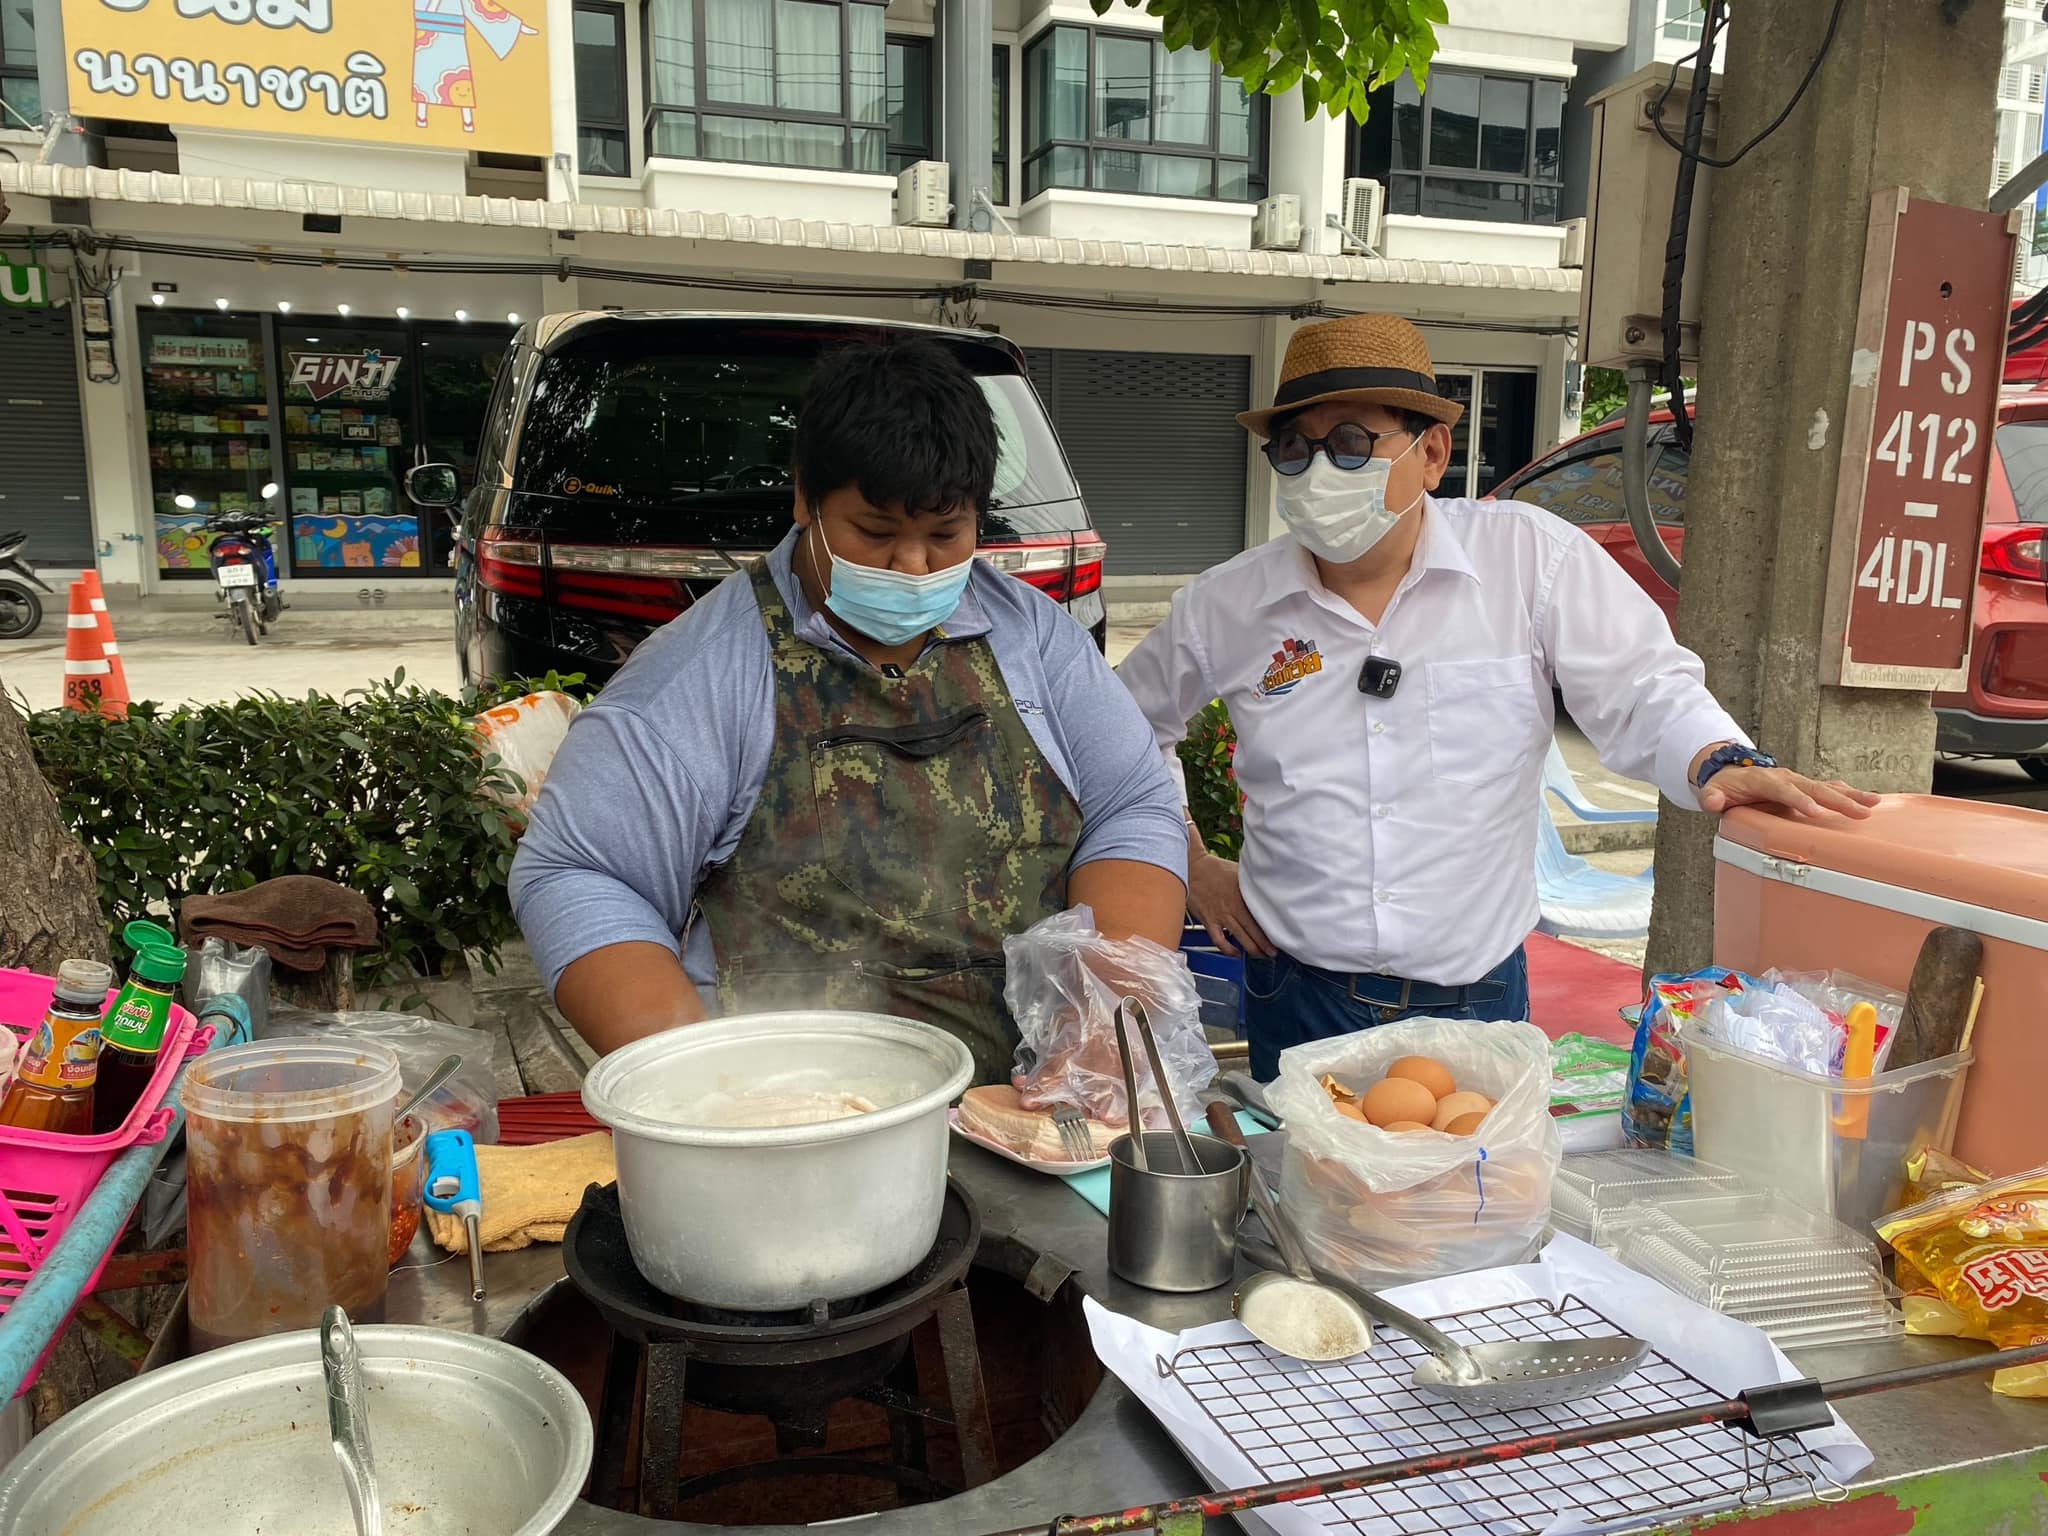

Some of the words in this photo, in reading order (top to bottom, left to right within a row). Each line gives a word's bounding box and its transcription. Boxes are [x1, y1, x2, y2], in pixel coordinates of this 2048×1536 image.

[75, 48, 389, 120] นานาชาติ
[1898, 319, 1976, 395] PS
[1875, 410, 1978, 485] 412
[1857, 536, 1963, 609] 4DL
